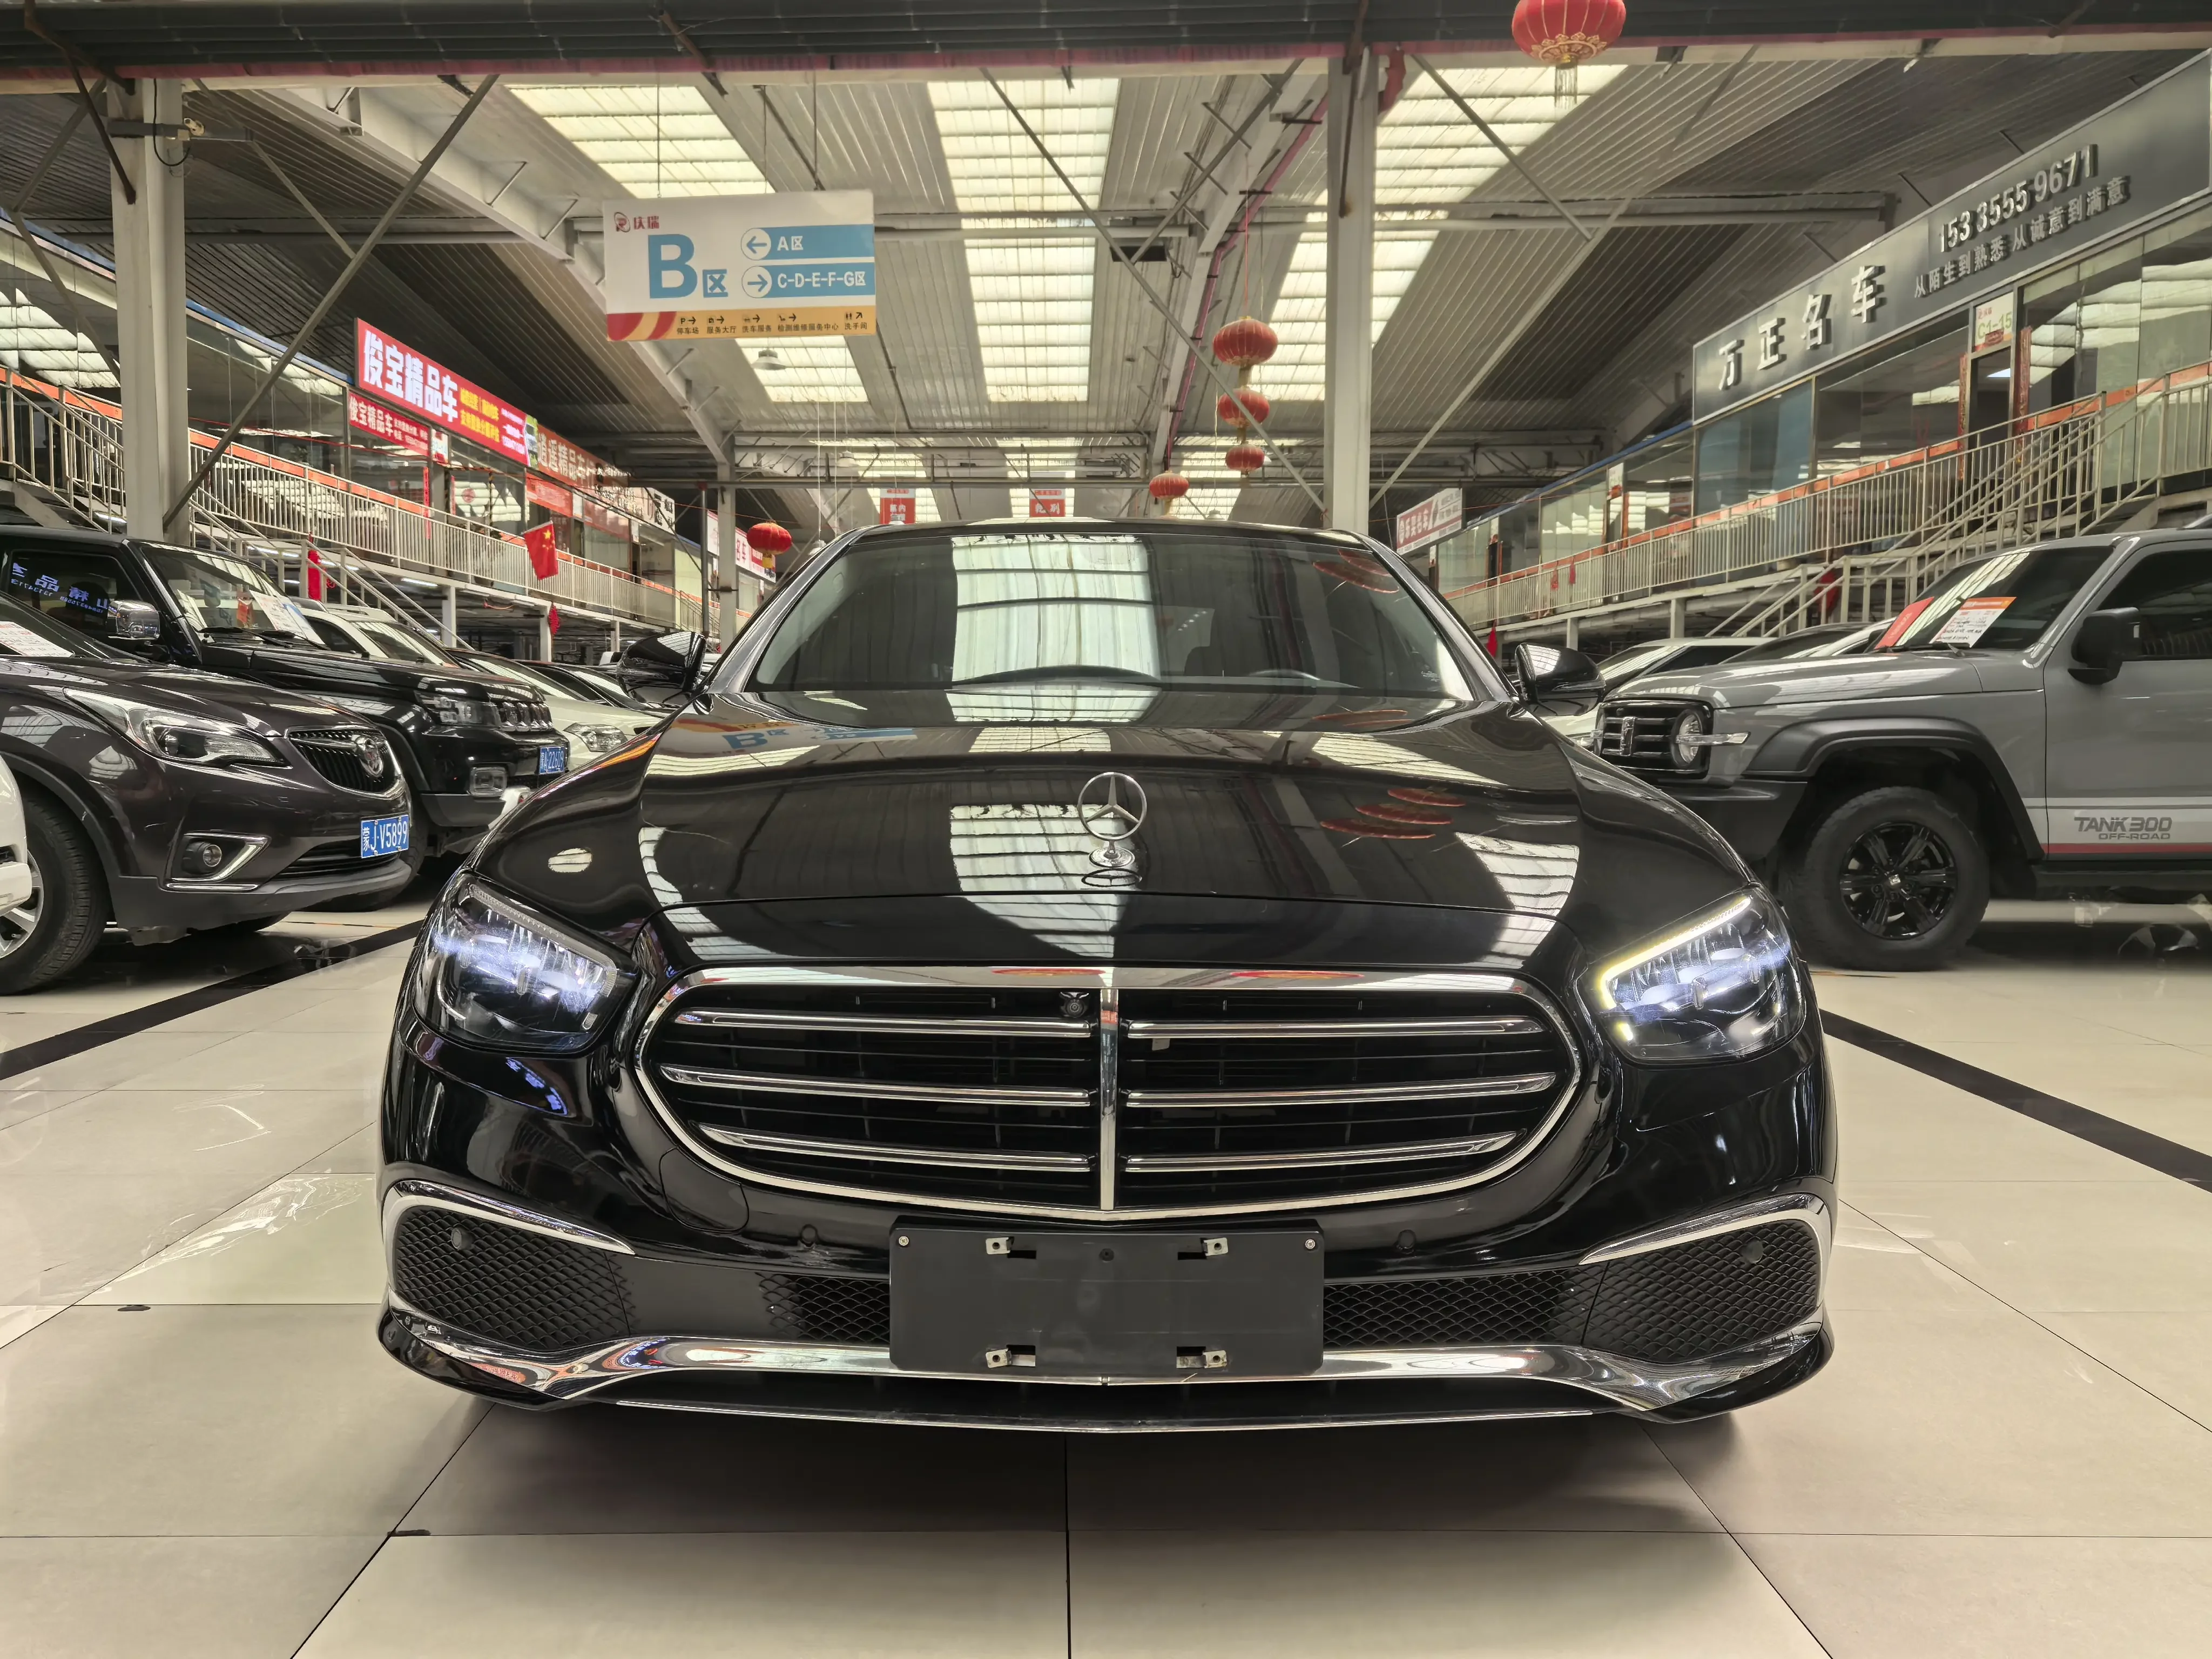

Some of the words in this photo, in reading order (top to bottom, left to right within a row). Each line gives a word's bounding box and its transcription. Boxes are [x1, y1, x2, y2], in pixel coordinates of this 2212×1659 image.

[1940, 210, 1973, 252] 153
[1976, 180, 2029, 233] 3555
[2034, 144, 2099, 203] 9671
[777, 235, 804, 251] A区
[777, 271, 866, 288] C-D-E-F-G区
[706, 326, 737, 334] 服务大厅
[845, 321, 867, 331] 洗手间
[1718, 265, 1881, 391] 方正名车
[363, 329, 458, 422] 俊宝精品车
[2074, 817, 2129, 832] TANK
[2129, 817, 2173, 832] 300
